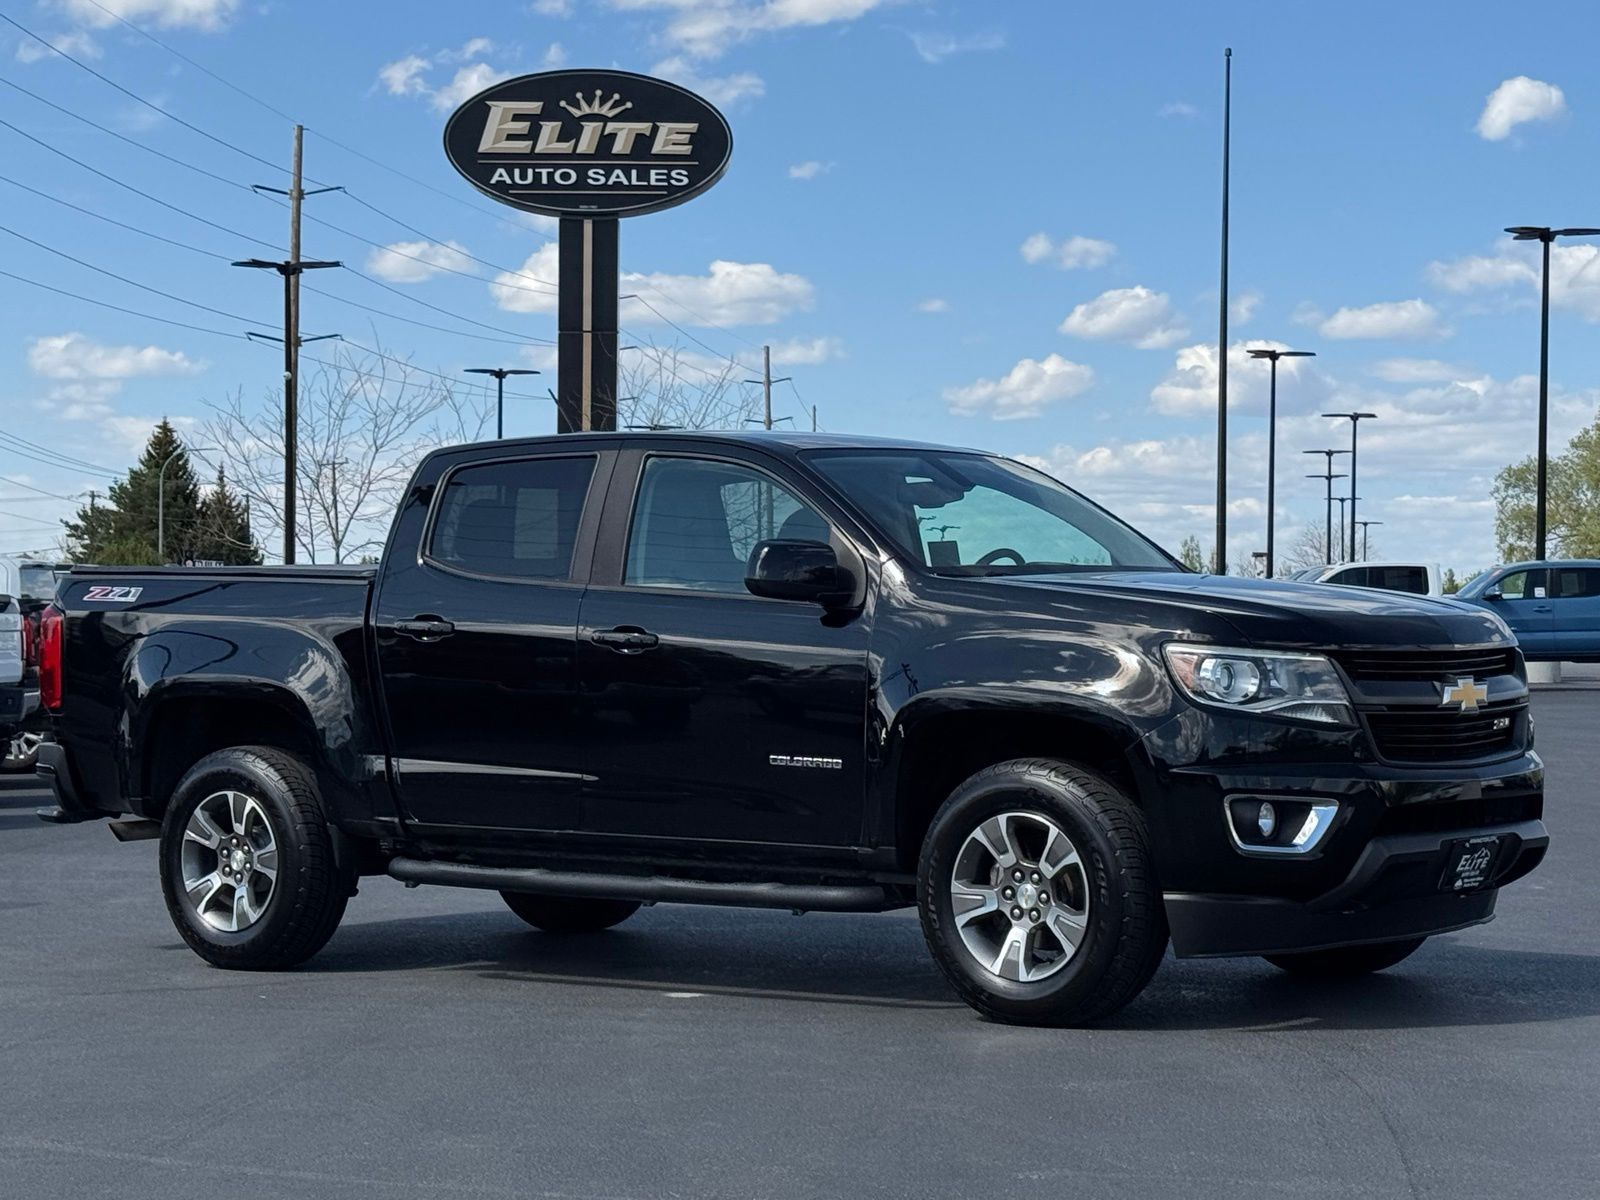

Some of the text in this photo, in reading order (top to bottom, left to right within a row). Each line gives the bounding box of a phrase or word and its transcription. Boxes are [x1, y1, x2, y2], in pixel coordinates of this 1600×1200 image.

[477, 100, 699, 155] ELITE
[490, 168, 689, 186] AUTO SALES
[82, 586, 143, 602] Z71
[769, 755, 842, 769] COLORADO
[1456, 854, 1488, 872] ELITE
